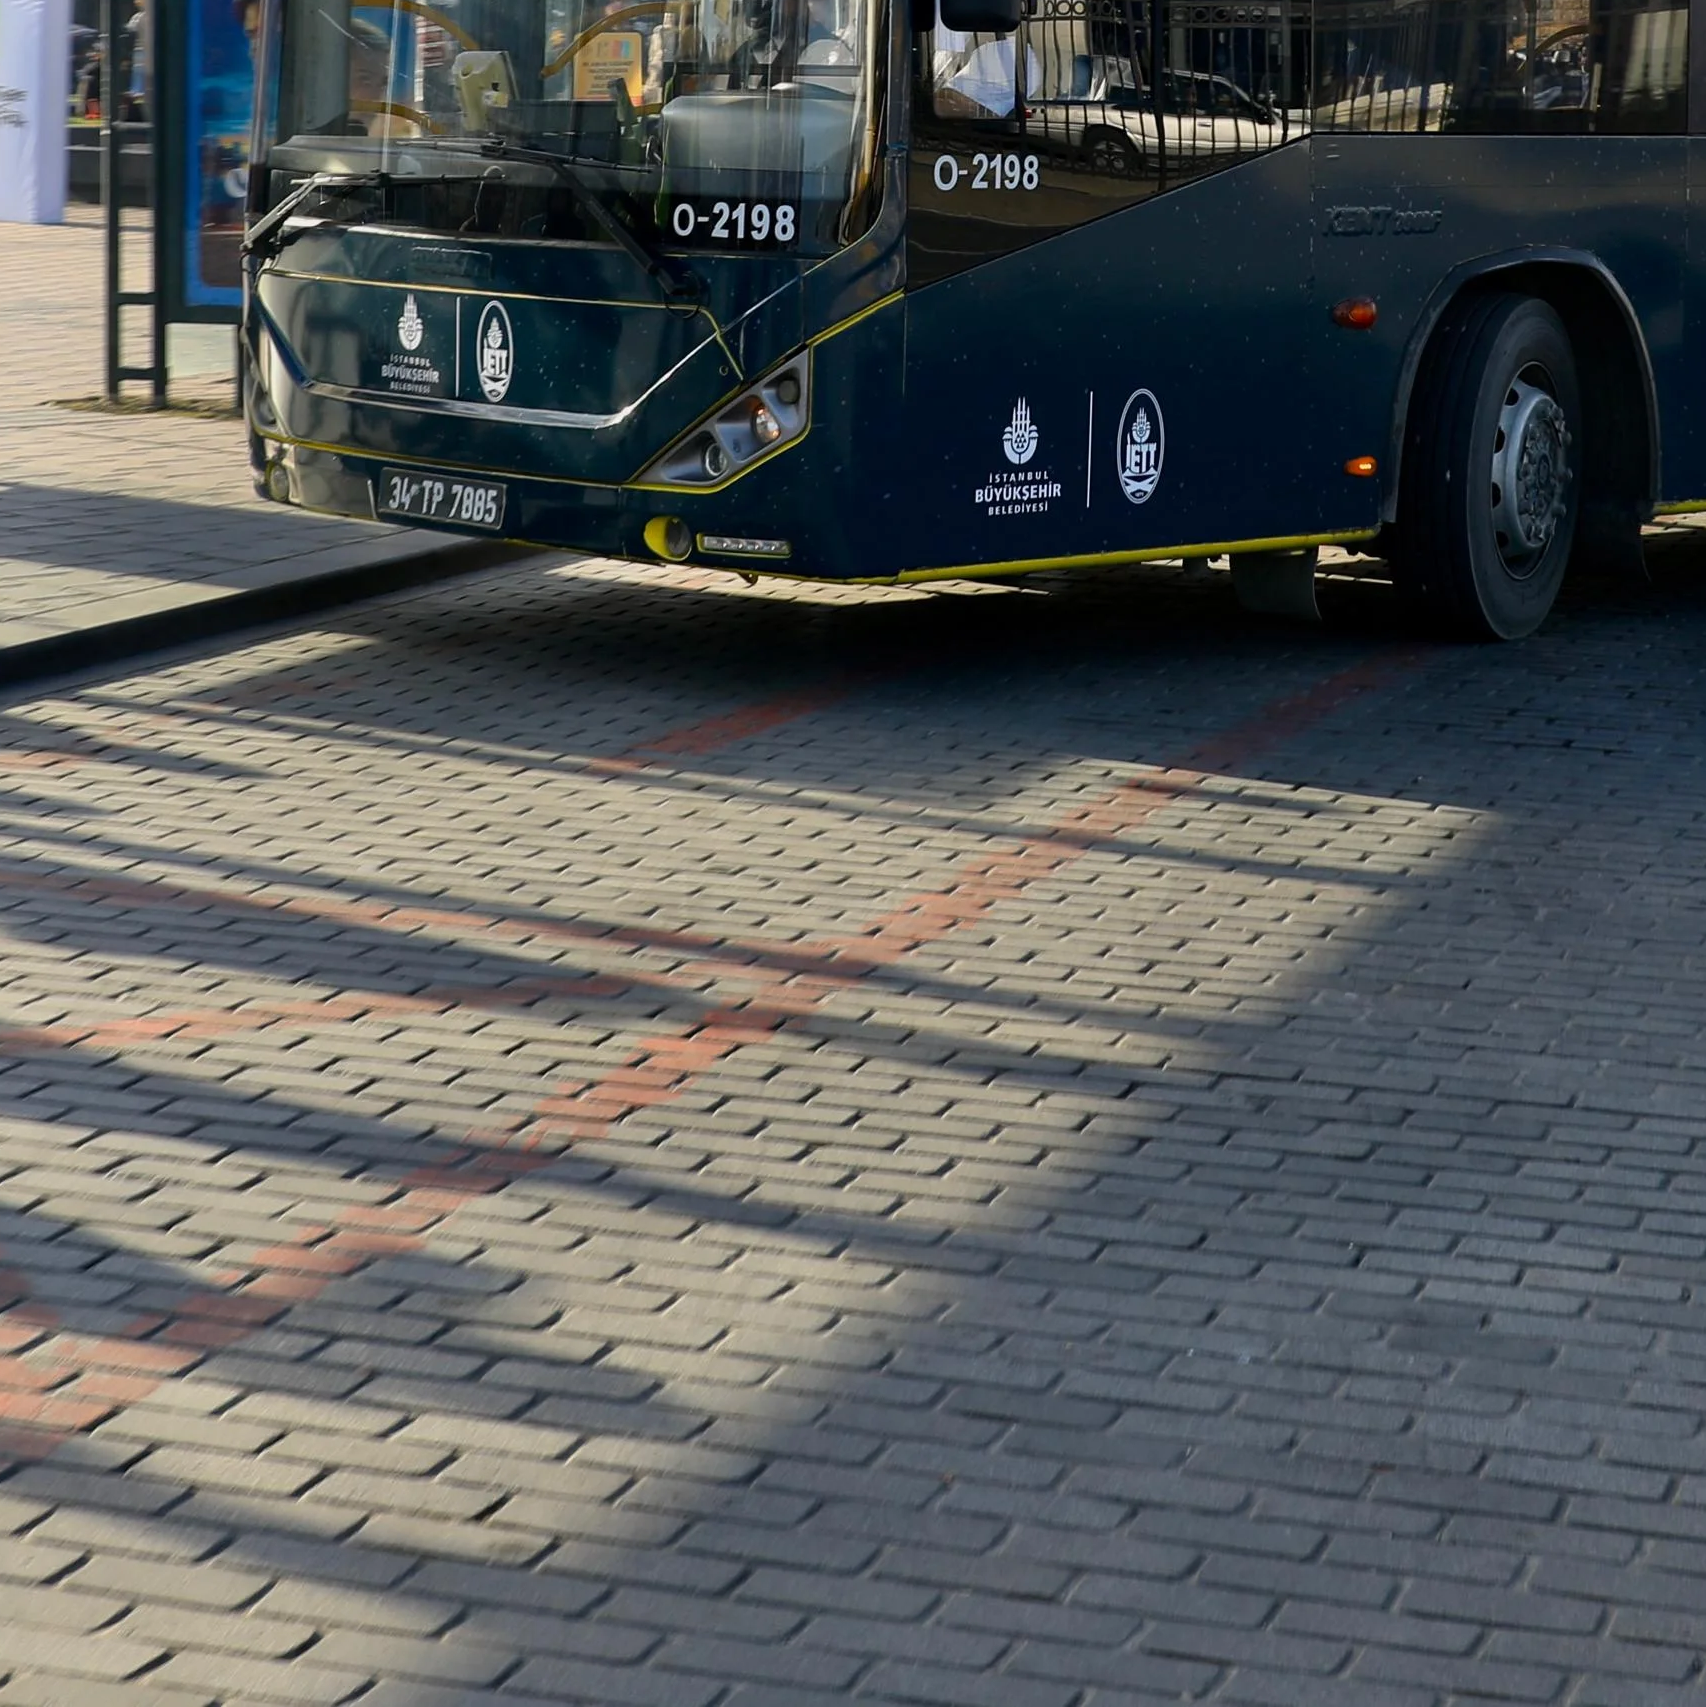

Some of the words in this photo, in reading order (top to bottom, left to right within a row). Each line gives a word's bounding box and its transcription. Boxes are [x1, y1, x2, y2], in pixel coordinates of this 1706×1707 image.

[933, 153, 1039, 191] O-2198
[672, 201, 795, 241] O-2198
[989, 470, 1049, 484] İSTANBUL
[388, 476, 413, 511] 34
[422, 480, 444, 515] TP
[448, 484, 498, 523] 7885
[974, 481, 1062, 504] BÜYÜKŞEHİR
[988, 500, 1049, 516] BELEDİYESİ
